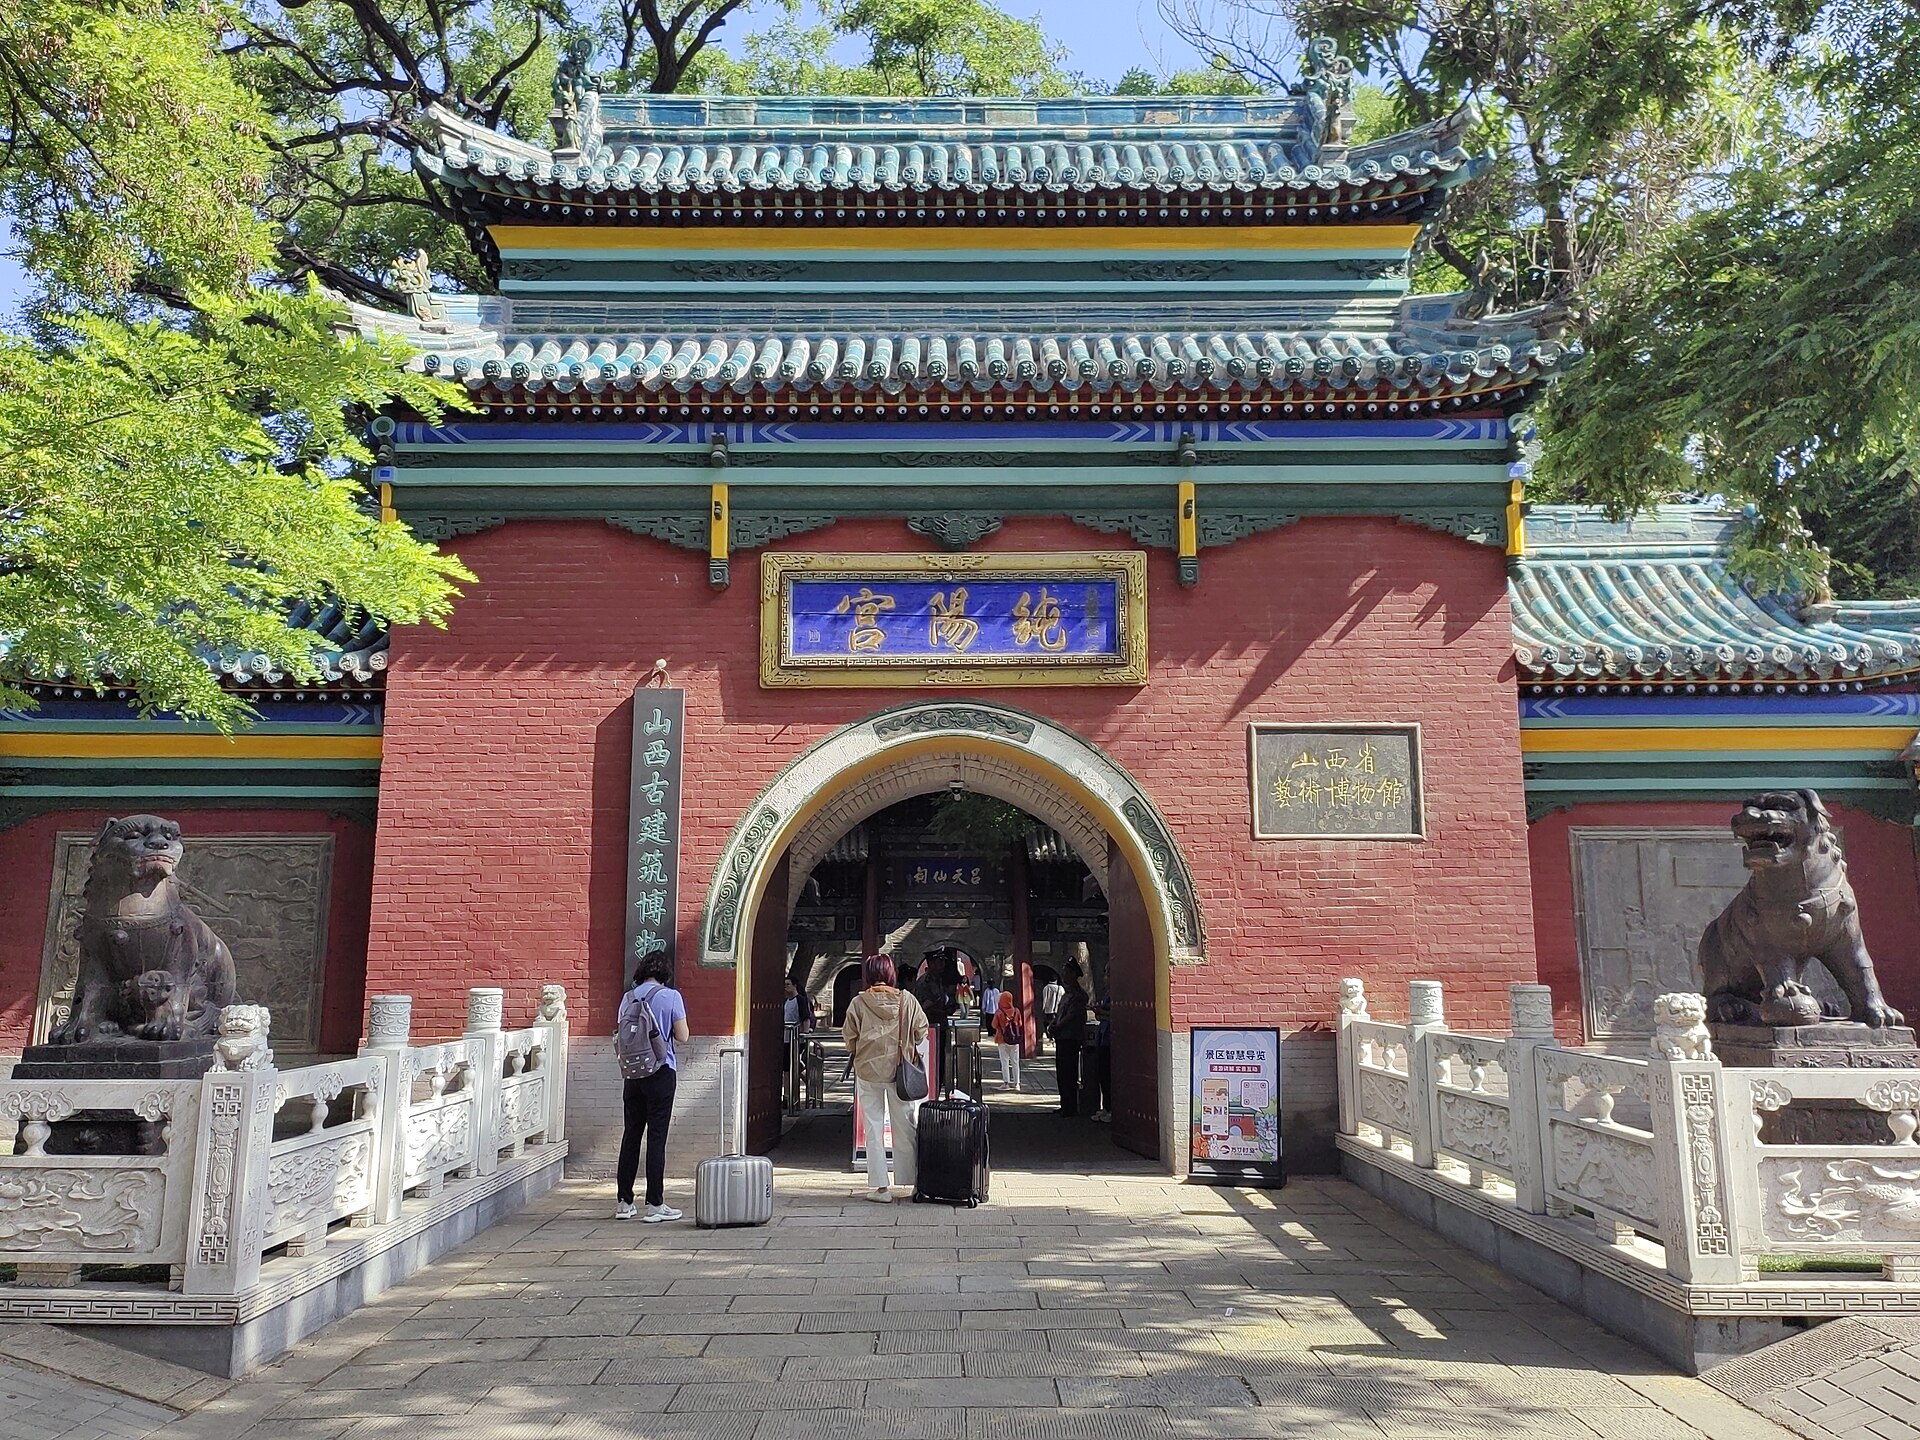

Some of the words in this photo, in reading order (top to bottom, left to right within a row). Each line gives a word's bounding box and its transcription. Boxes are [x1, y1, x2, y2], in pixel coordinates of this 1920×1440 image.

[1292, 742, 1377, 774] 山西省
[1205, 1050, 1266, 1061] 景区智慧导览
